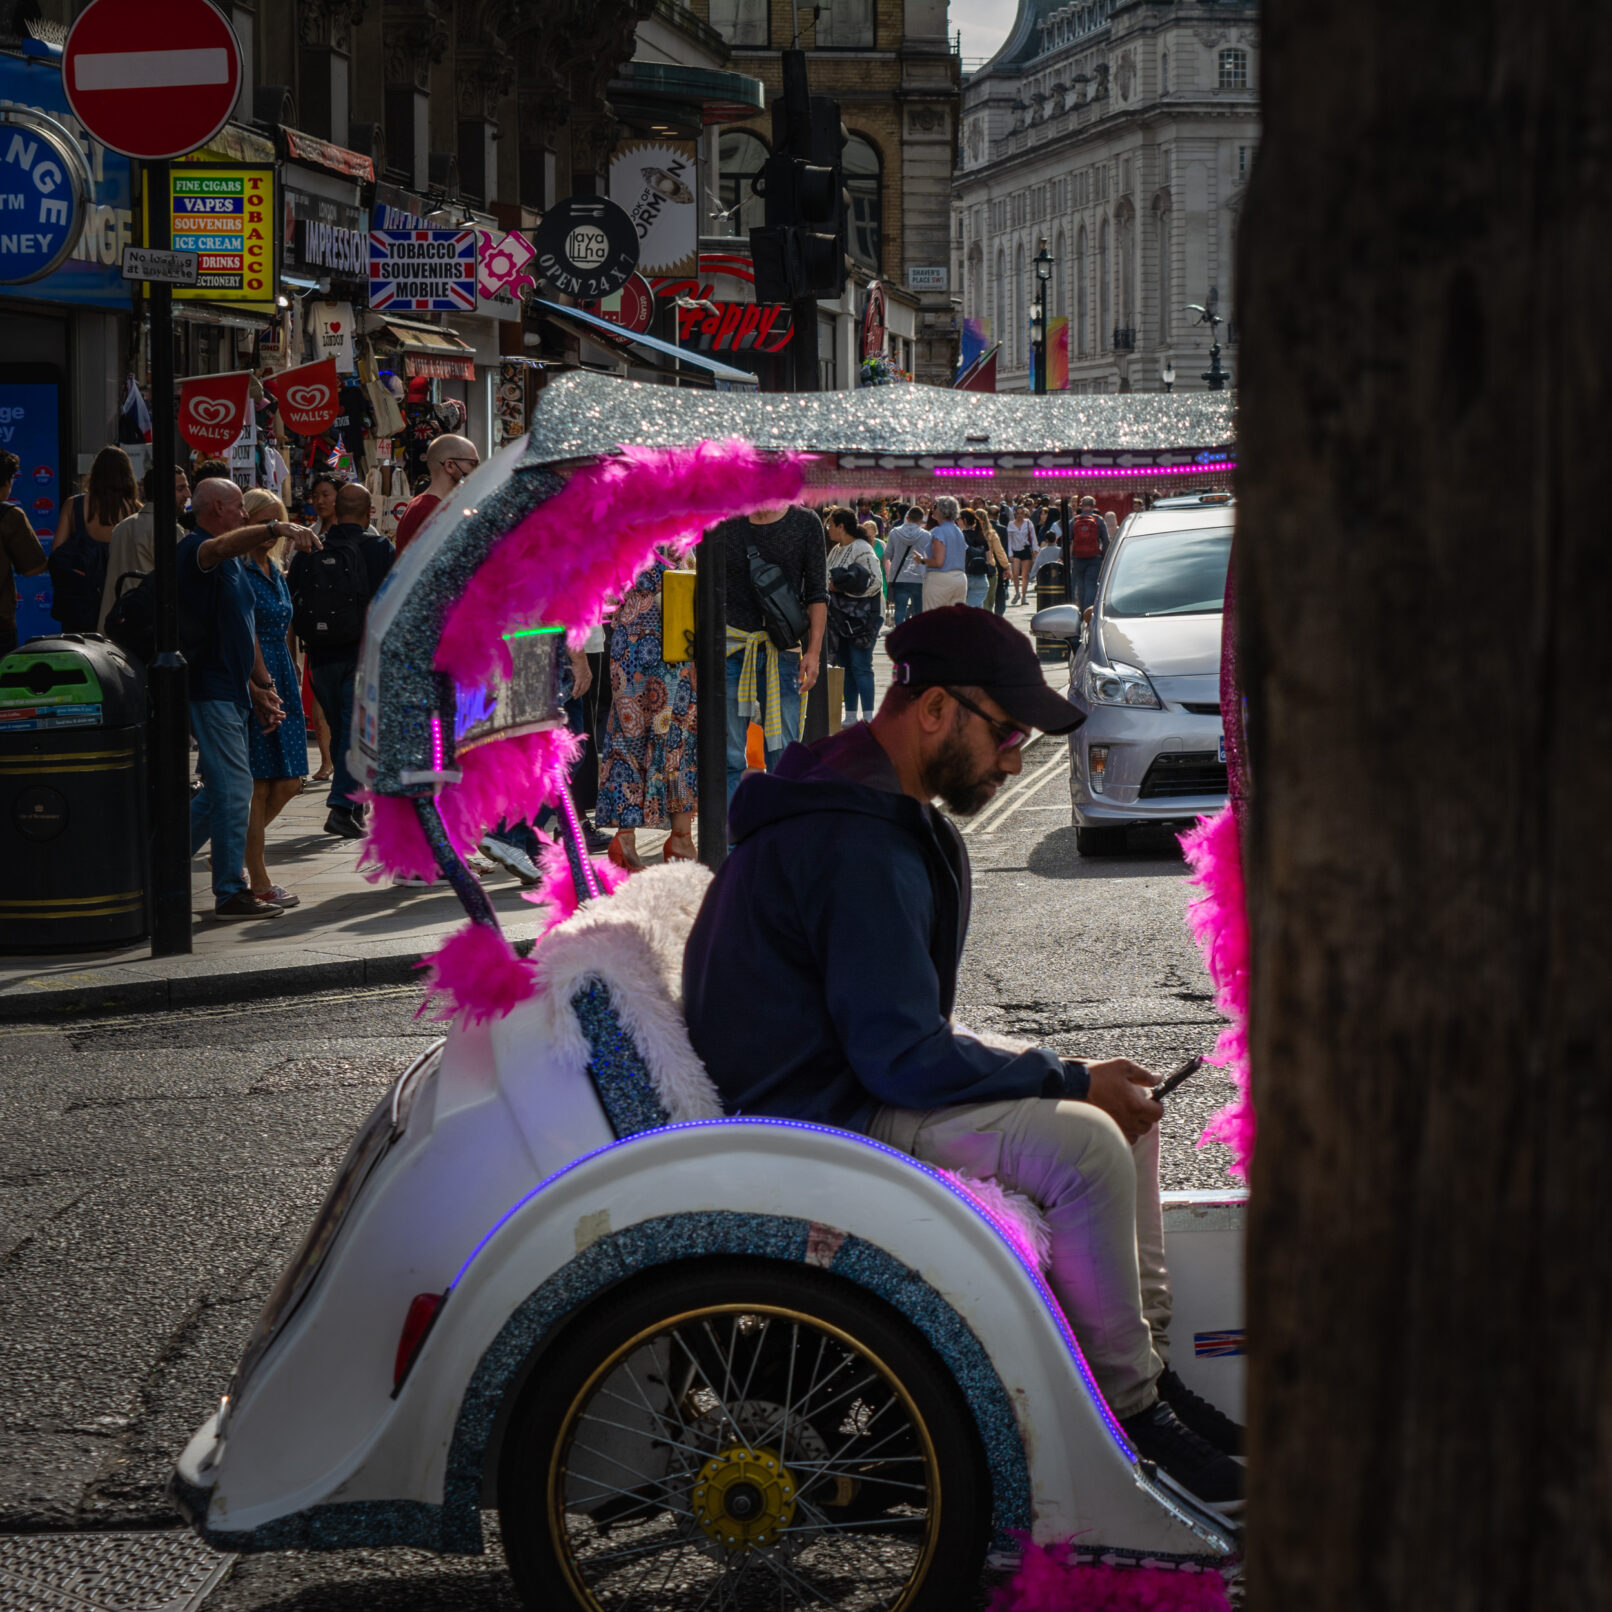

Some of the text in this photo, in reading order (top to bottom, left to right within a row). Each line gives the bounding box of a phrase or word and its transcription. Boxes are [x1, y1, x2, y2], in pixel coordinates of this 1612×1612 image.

[0, 133, 69, 226] NGE
[175, 180, 242, 191] FINE CIGARS
[183, 198, 234, 212] VAPES
[174, 218, 242, 231] SOUVENIRS
[72, 203, 132, 266] NGE
[247, 177, 264, 290] TOBACCO
[175, 237, 242, 250] ICE CREAM
[304, 219, 369, 275] IMPRESSION
[129, 252, 146, 262] No
[387, 243, 456, 259] TOBACCO
[127, 265, 139, 274] at
[202, 257, 241, 269] DRINKS
[381, 262, 463, 279] SOUVENIRS
[540, 253, 635, 295] OPEN 24 X 7
[196, 275, 241, 287] ECTIONERY
[912, 276, 930, 284] PLACE
[396, 282, 449, 298] MOBILE
[656, 280, 782, 351] Happy
[322, 335, 344, 347] LONDON
[289, 410, 329, 422] WALL'S
[188, 424, 230, 440] WALL'S
